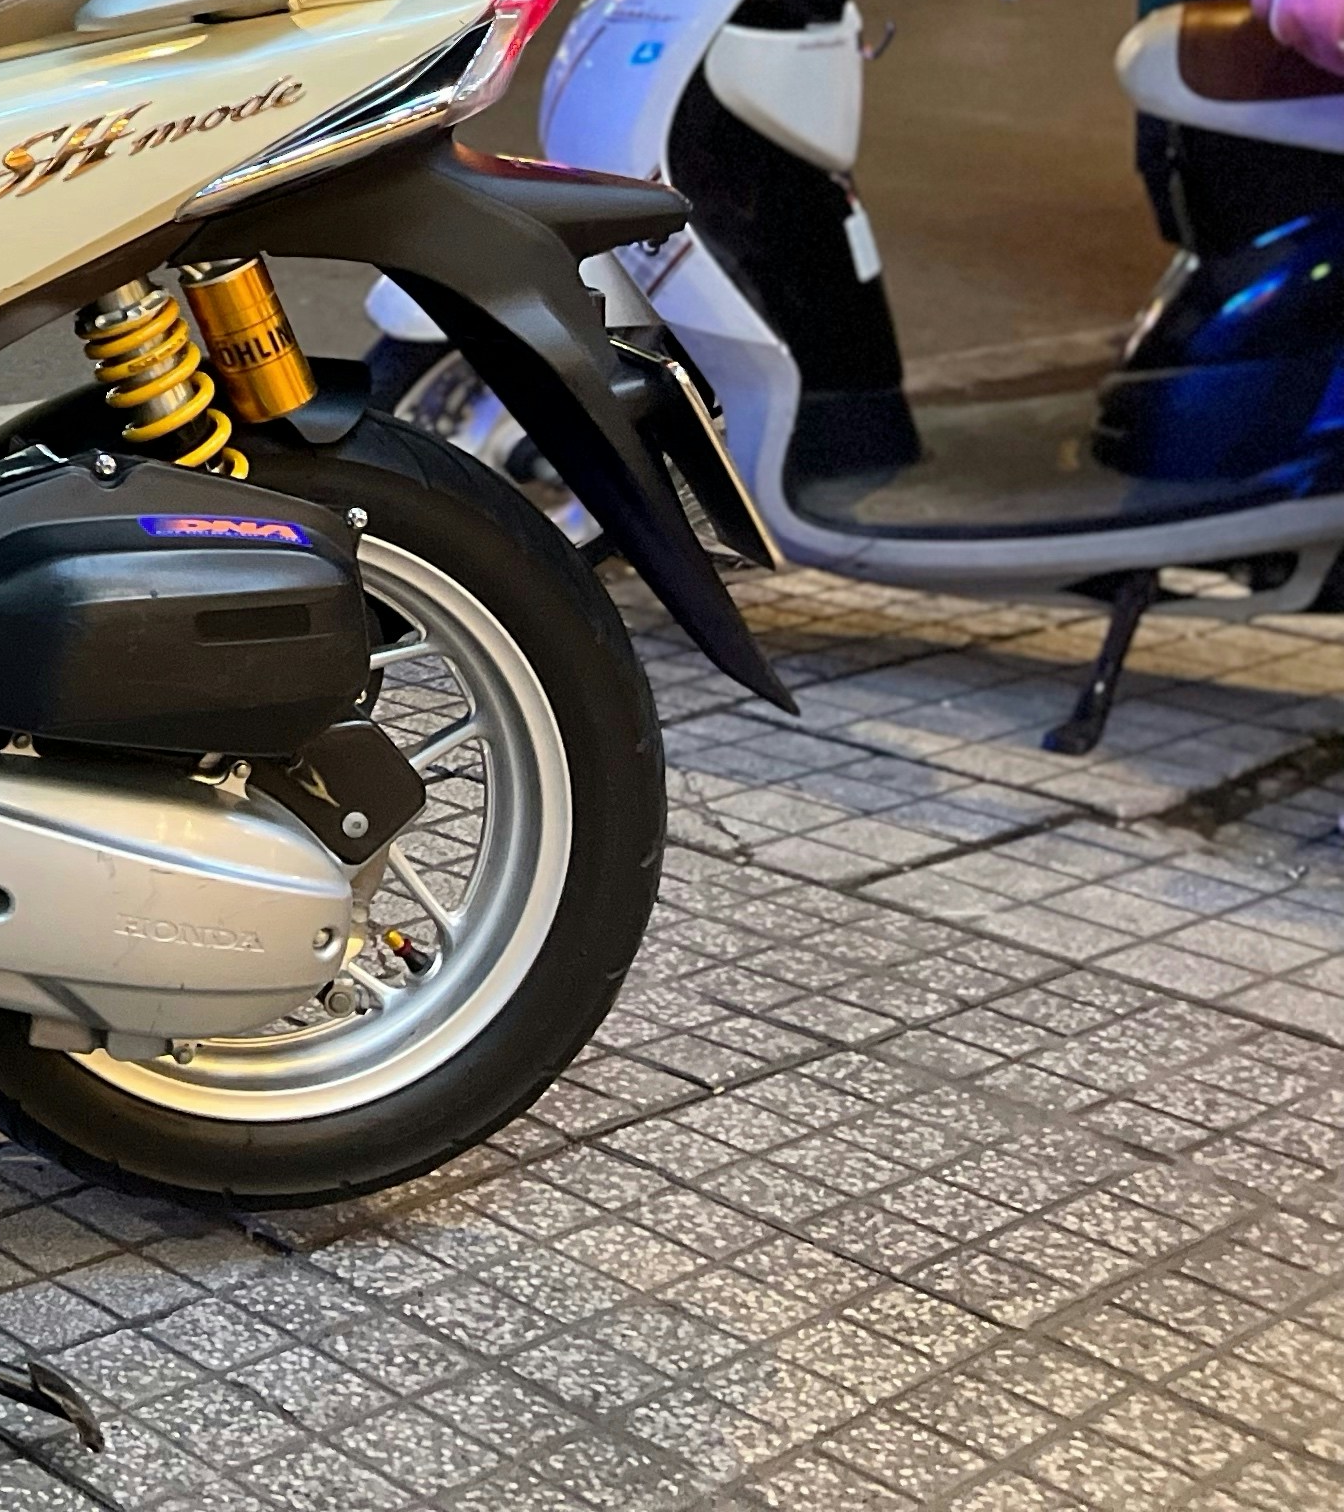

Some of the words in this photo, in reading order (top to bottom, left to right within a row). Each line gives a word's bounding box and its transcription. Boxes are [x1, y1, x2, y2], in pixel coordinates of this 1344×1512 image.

[127, 74, 304, 156] mode
[172, 518, 299, 541] DNA
[113, 912, 265, 952] HONDA
